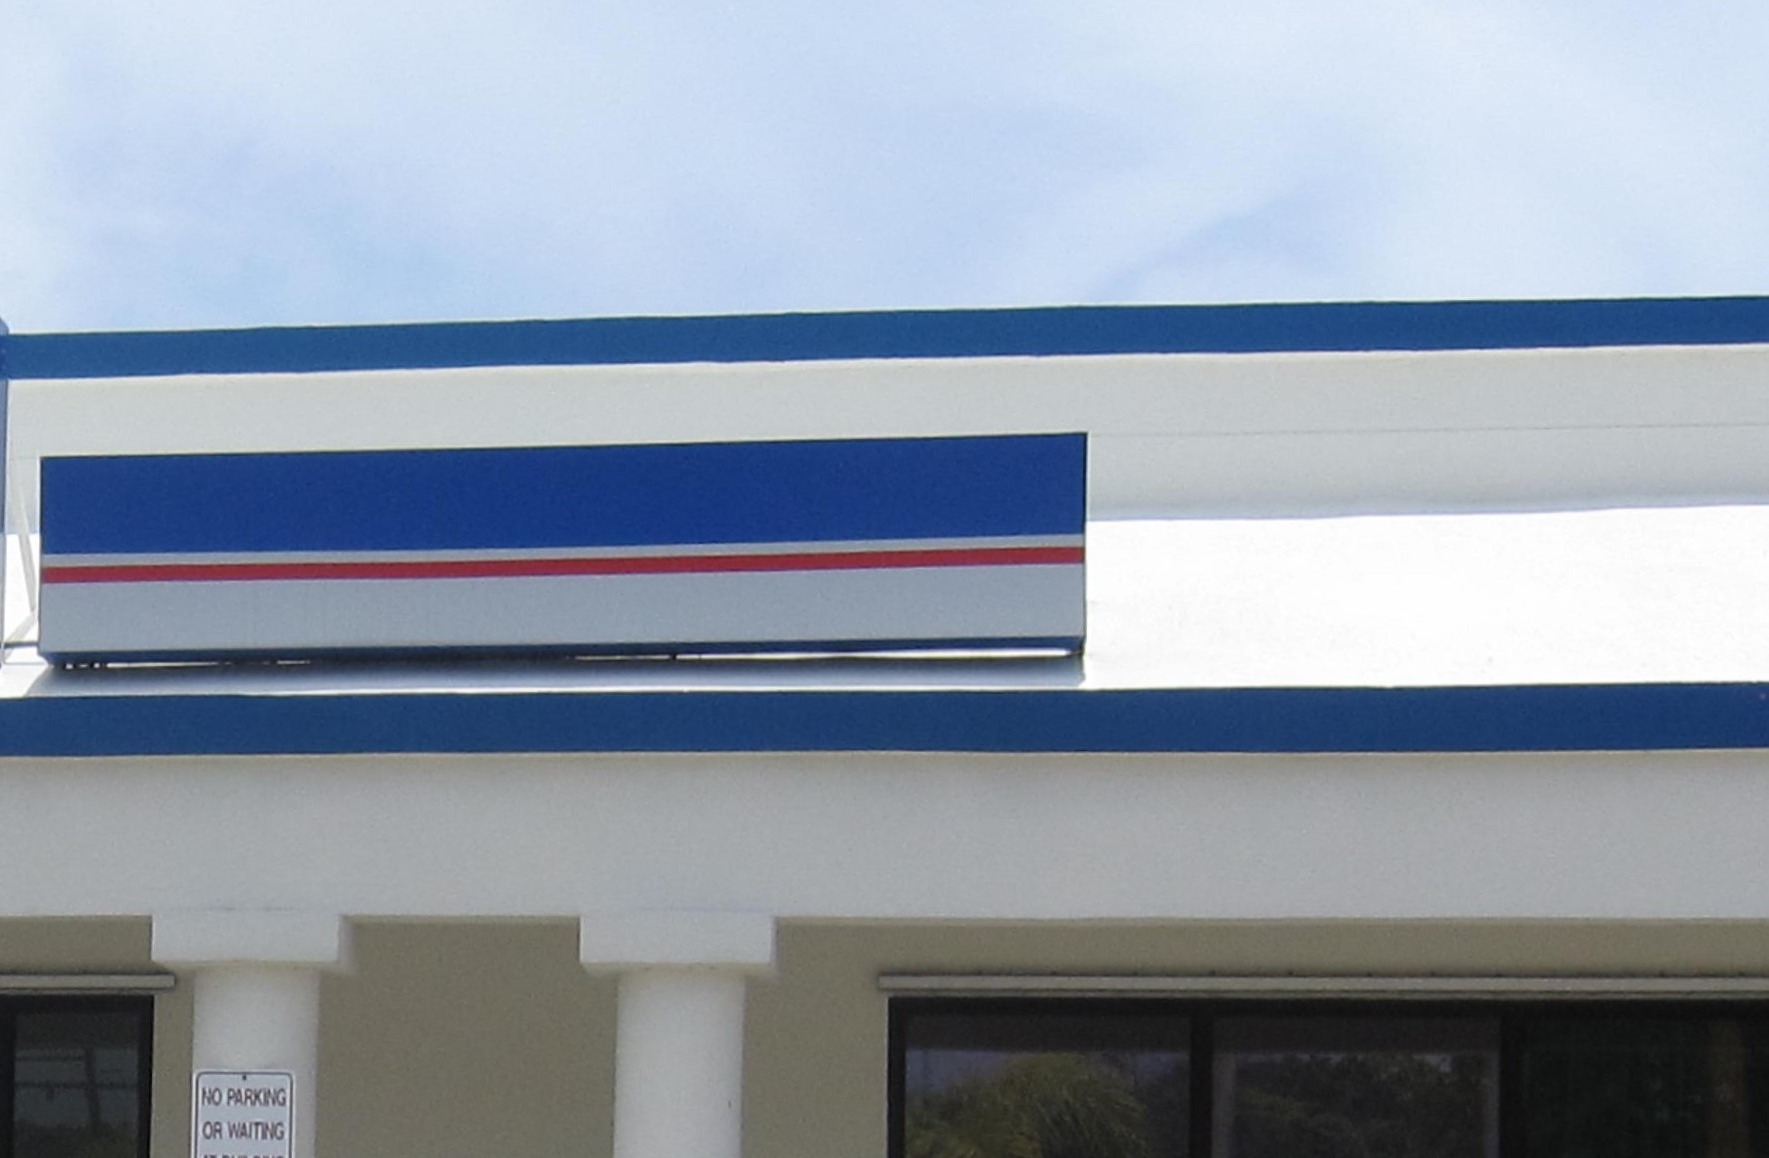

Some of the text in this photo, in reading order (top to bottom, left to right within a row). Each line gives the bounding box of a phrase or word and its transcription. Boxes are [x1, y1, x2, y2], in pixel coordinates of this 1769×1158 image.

[201, 1087, 287, 1107] NO PARKING
[202, 1121, 285, 1141] OR WAITING
